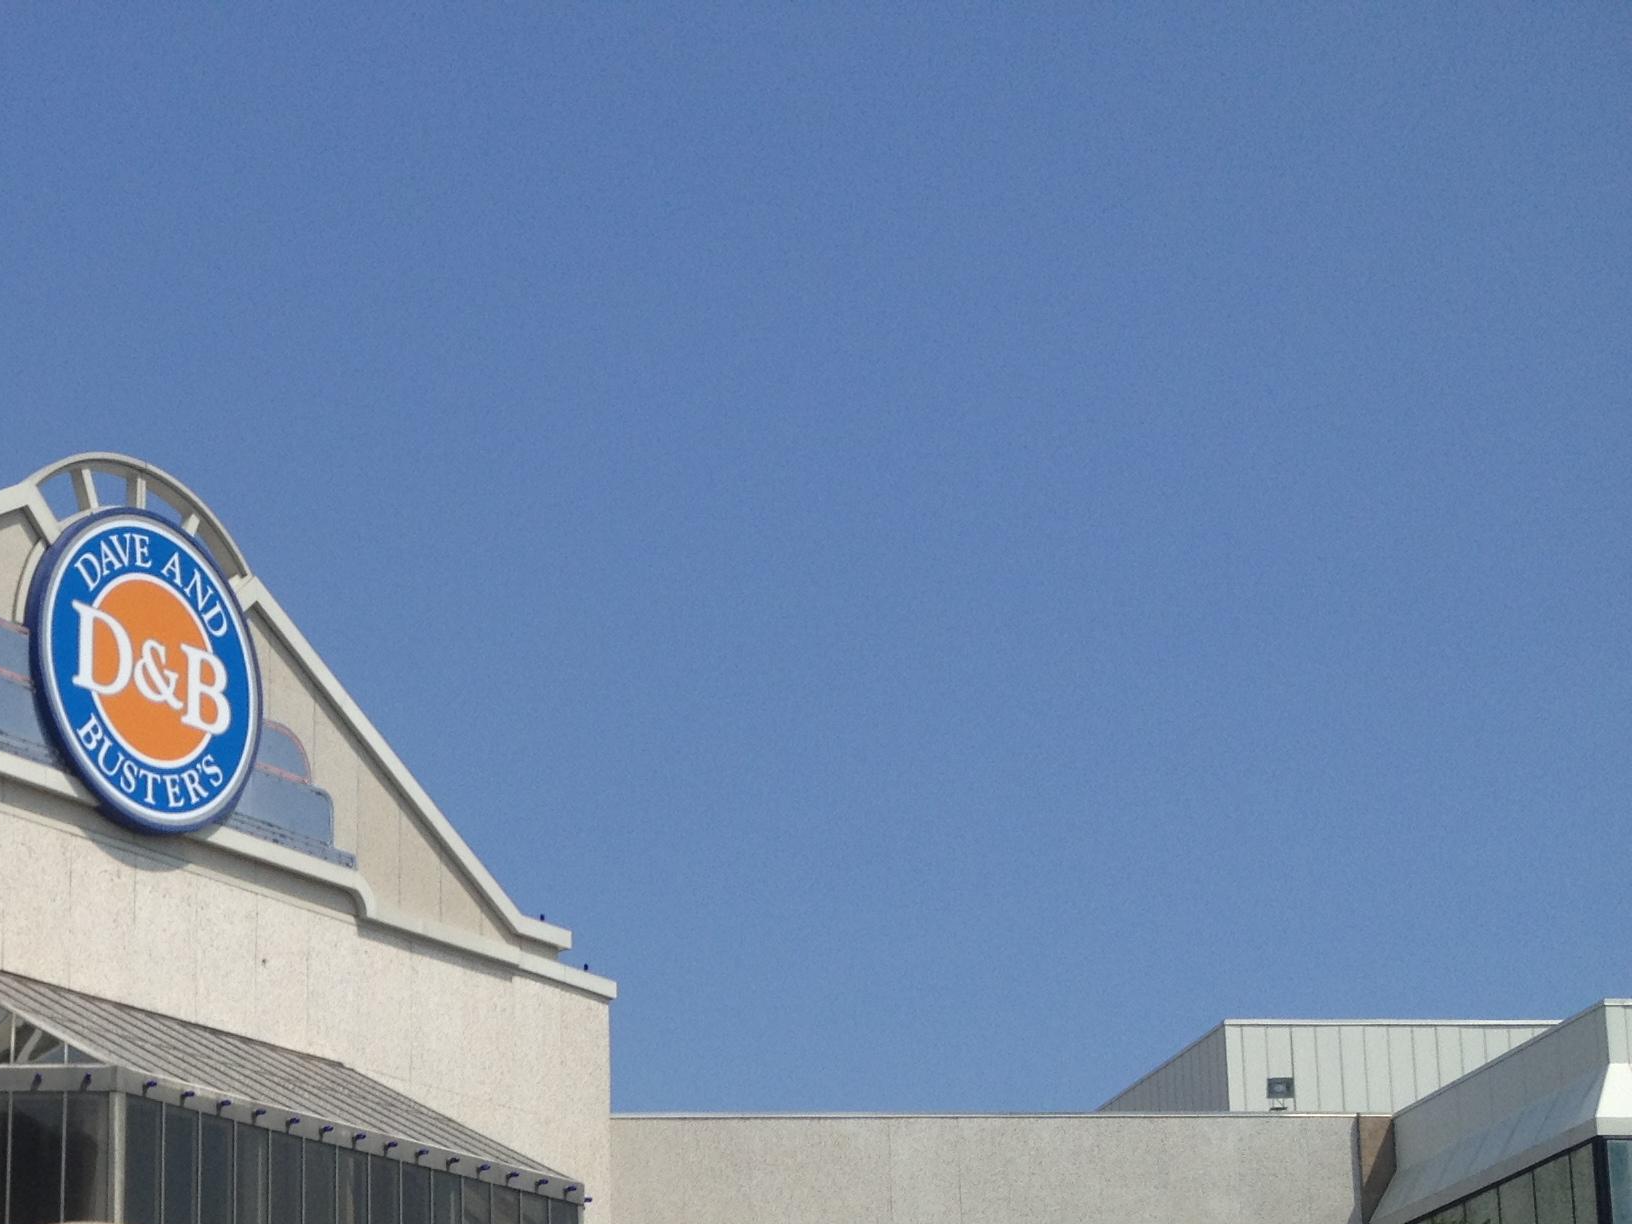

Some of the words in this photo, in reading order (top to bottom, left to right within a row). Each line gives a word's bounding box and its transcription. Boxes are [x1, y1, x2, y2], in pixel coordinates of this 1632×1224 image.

[74, 533, 152, 592] DAVE
[160, 552, 229, 639] AND
[71, 599, 232, 735] D&B
[76, 713, 224, 808] BUSTER'S
